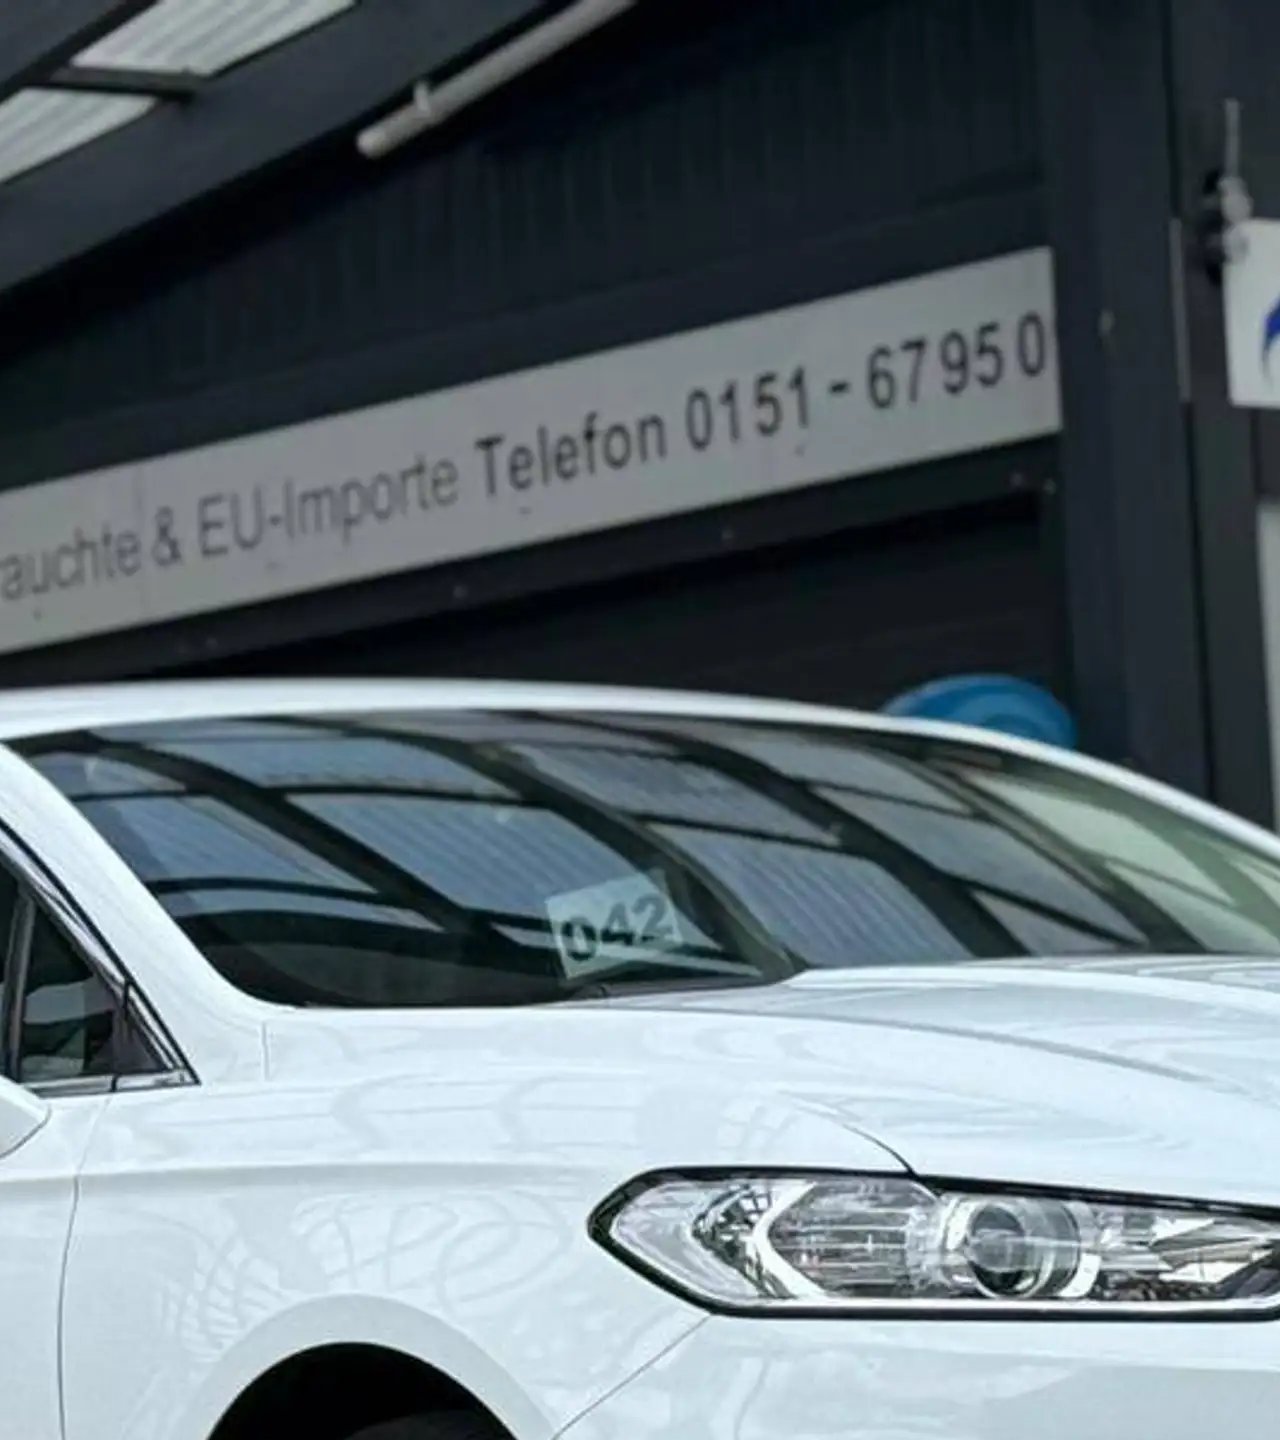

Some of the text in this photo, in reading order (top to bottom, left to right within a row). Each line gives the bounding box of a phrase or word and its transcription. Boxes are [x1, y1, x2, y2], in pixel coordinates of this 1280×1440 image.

[151, 506, 182, 564] &
[197, 456, 459, 558] EU-Importe
[474, 408, 667, 498] Telefon
[686, 366, 809, 452] 0151
